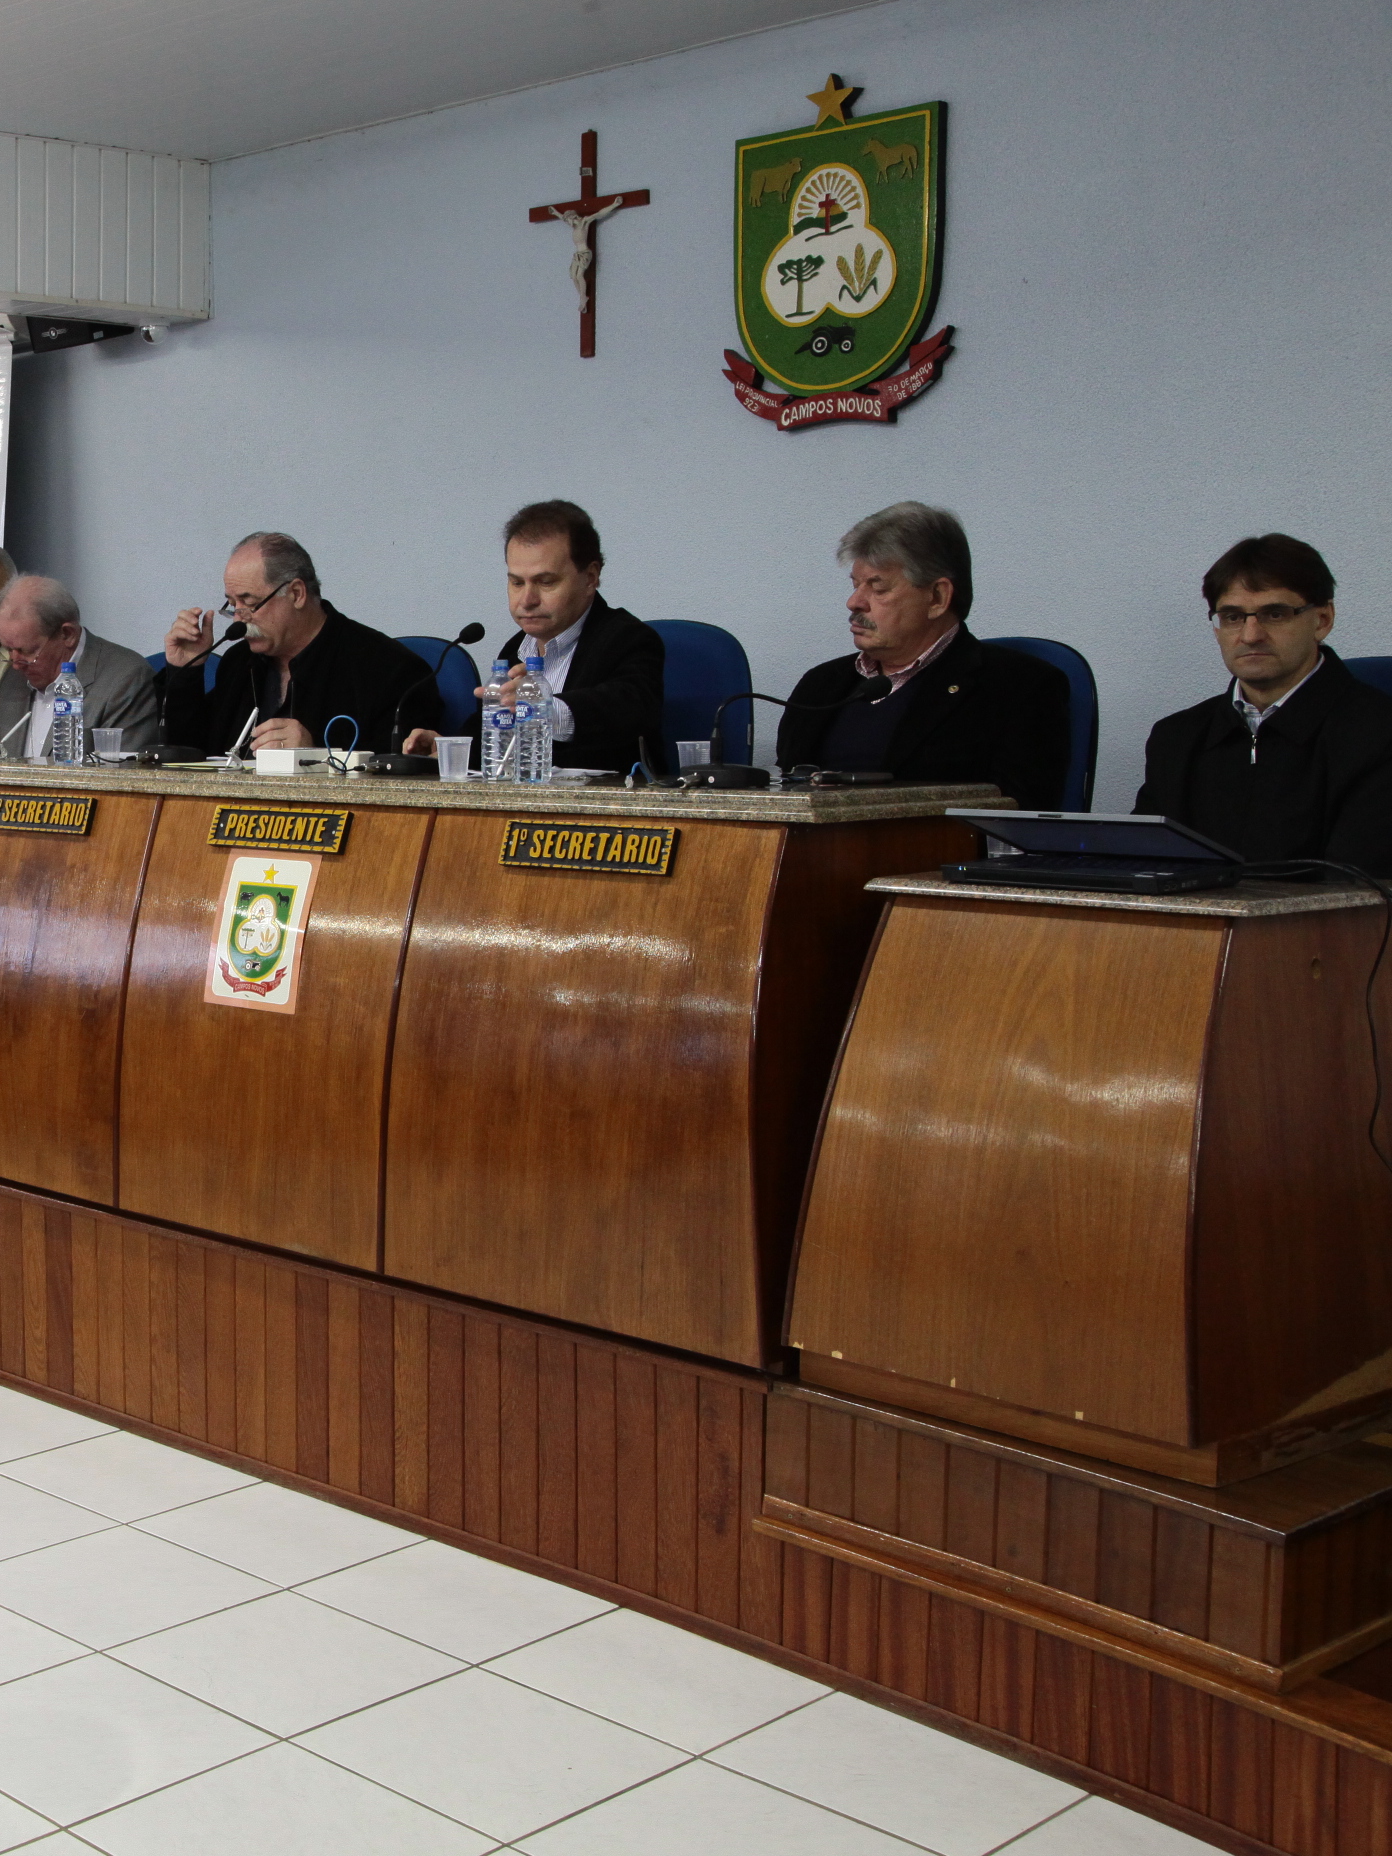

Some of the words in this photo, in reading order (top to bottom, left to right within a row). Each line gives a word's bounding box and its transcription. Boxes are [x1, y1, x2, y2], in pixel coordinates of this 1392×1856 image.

[735, 381, 745, 392] LEI
[744, 386, 778, 408] PROVINCIAL
[896, 389, 908, 400] DE
[900, 377, 910, 389] DE
[780, 398, 834, 426] CAMPOS
[837, 397, 882, 417] NOVOS
[1, 798, 86, 827] SECRETÁRIO
[224, 813, 329, 843] PRESIDENTE
[529, 829, 663, 866] SECRETÁRIO
